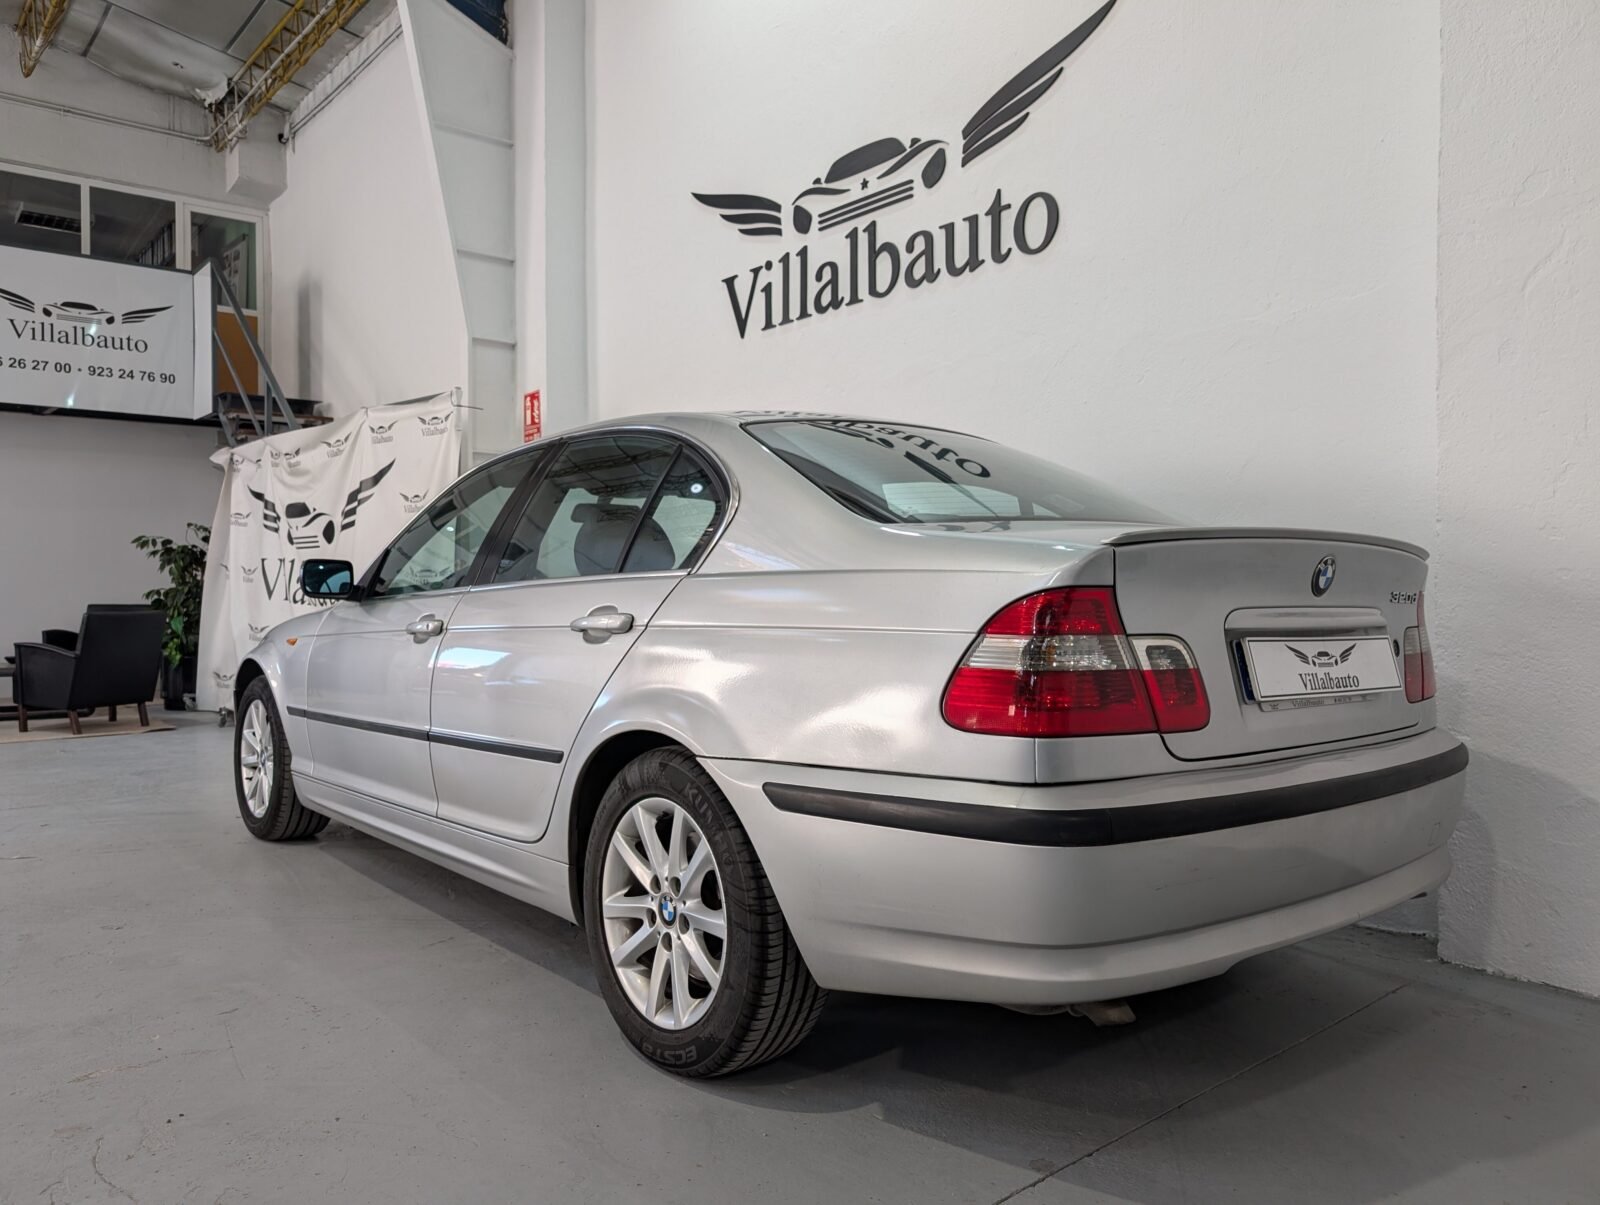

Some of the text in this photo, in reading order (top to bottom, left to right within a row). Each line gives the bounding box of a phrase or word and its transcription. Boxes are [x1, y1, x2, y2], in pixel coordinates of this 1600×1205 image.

[721, 188, 1060, 339] Villalbauto
[7, 318, 148, 353] Villalbauto
[8, 357, 26, 369] 26
[31, 359, 49, 371] 27
[54, 361, 72, 374] 00
[88, 365, 113, 378] 923
[118, 368, 135, 380] 24
[139, 370, 156, 382] 76
[159, 373, 176, 384] 90
[1298, 672, 1360, 691] Villalbauto
